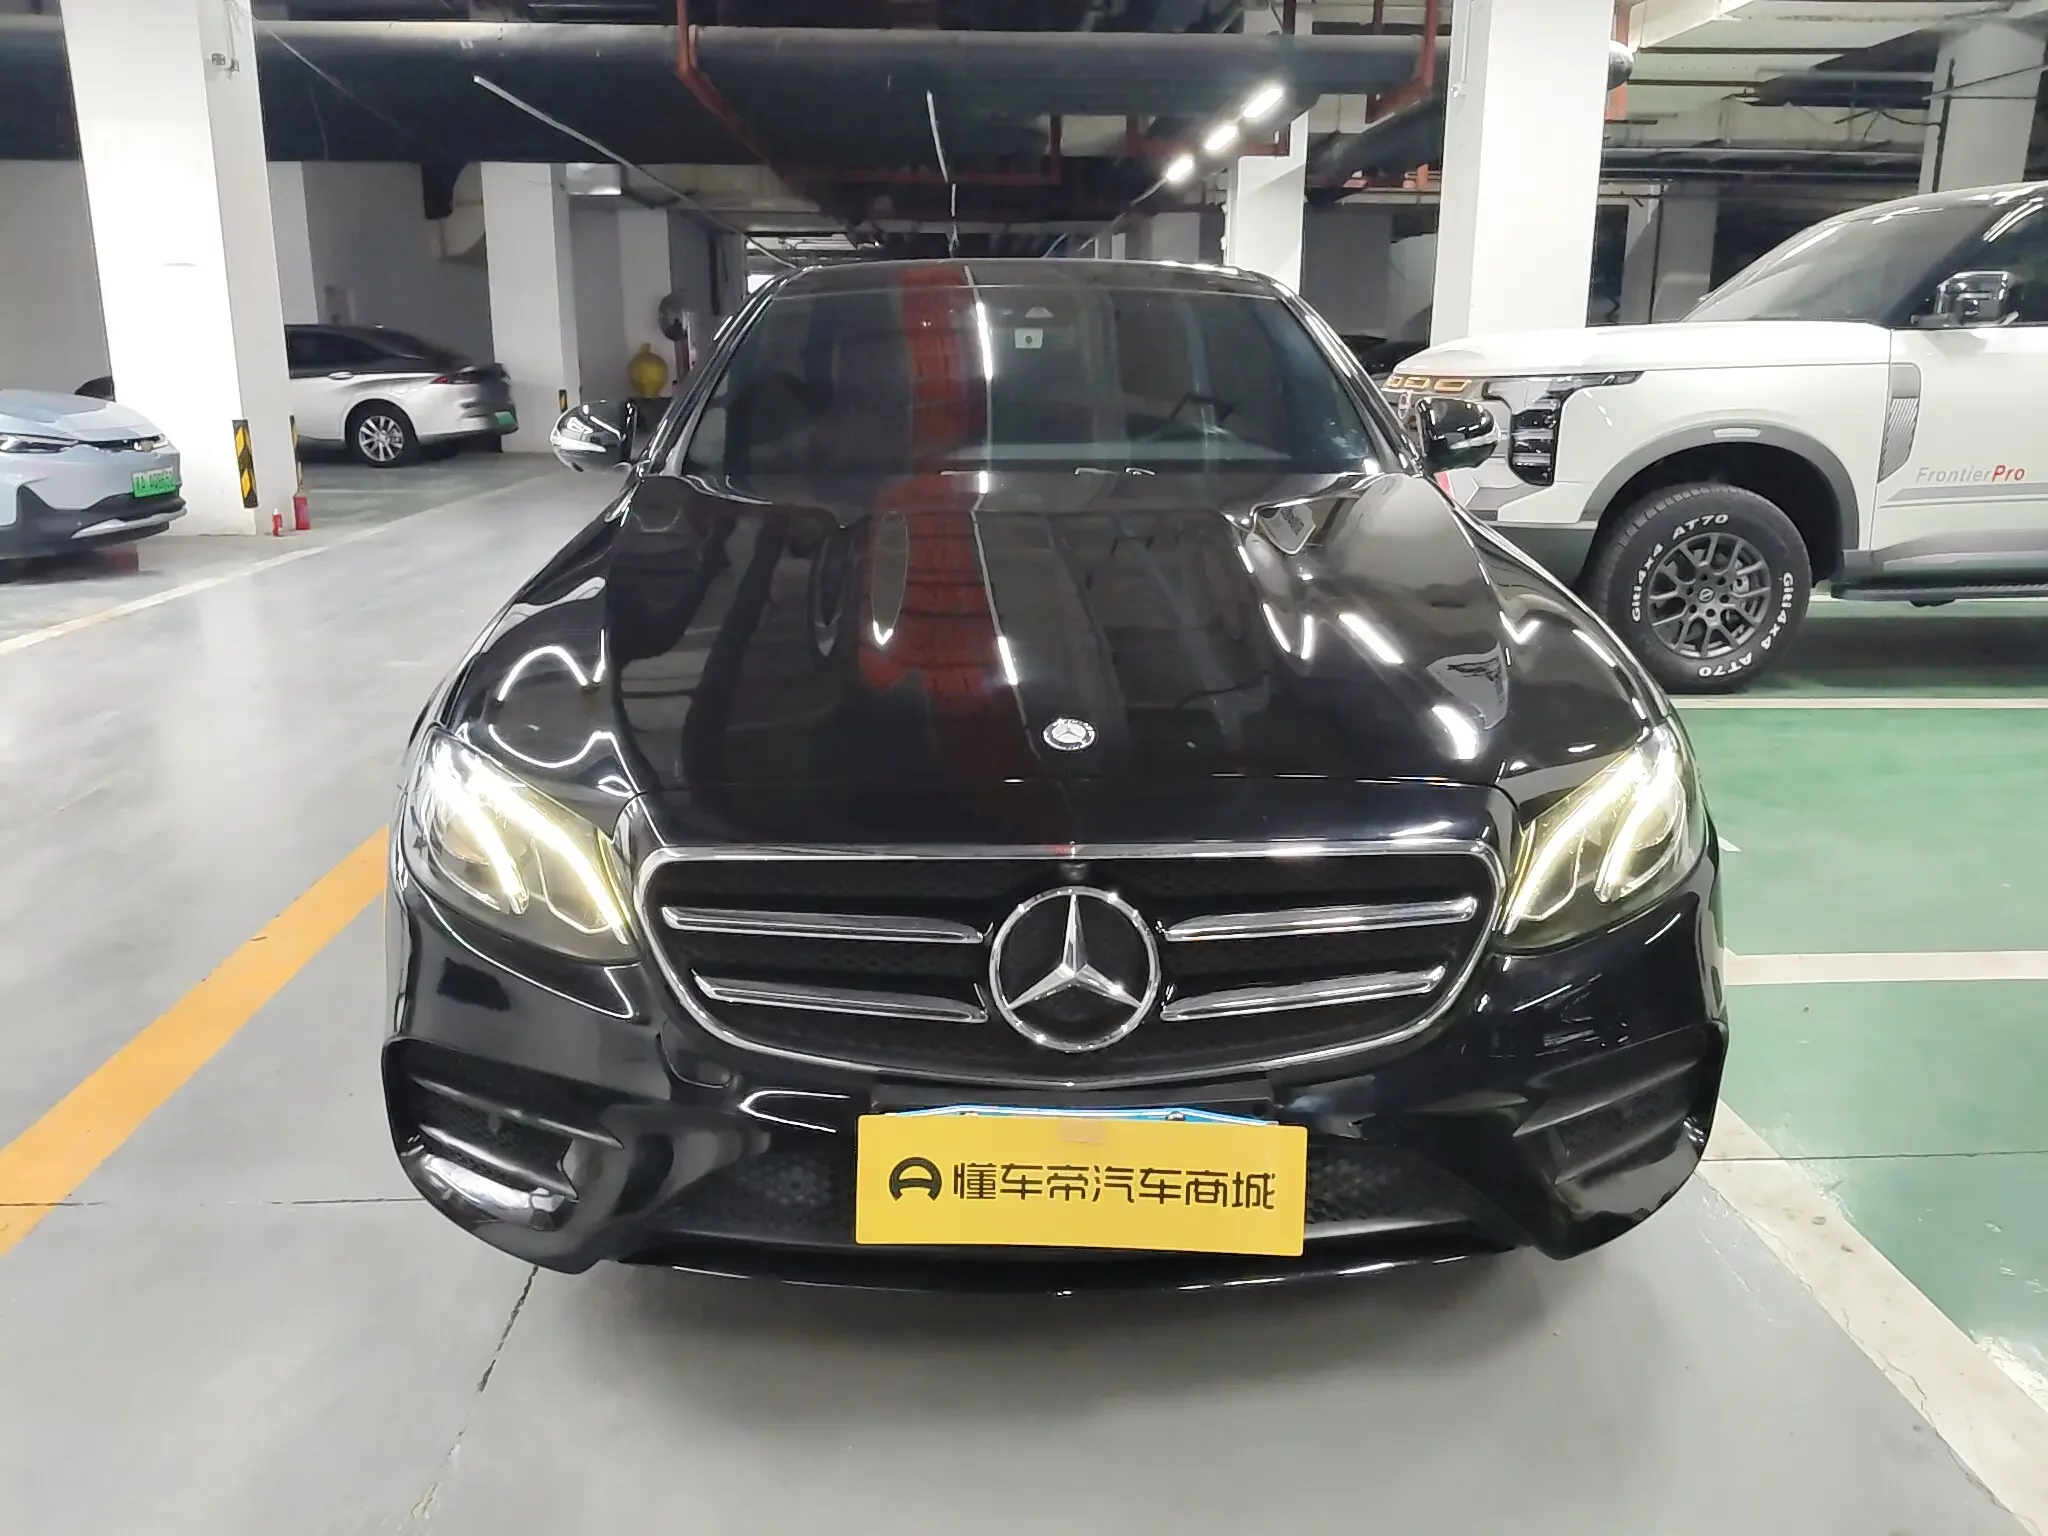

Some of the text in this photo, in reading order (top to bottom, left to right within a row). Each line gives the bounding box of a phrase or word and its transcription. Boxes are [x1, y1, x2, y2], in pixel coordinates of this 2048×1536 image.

[1915, 464, 2025, 483] FrontierPro
[1672, 513, 1729, 540] AT70
[1699, 652, 1752, 677] AT70
[953, 1162, 1276, 1210] 懂车帝汽车商城
